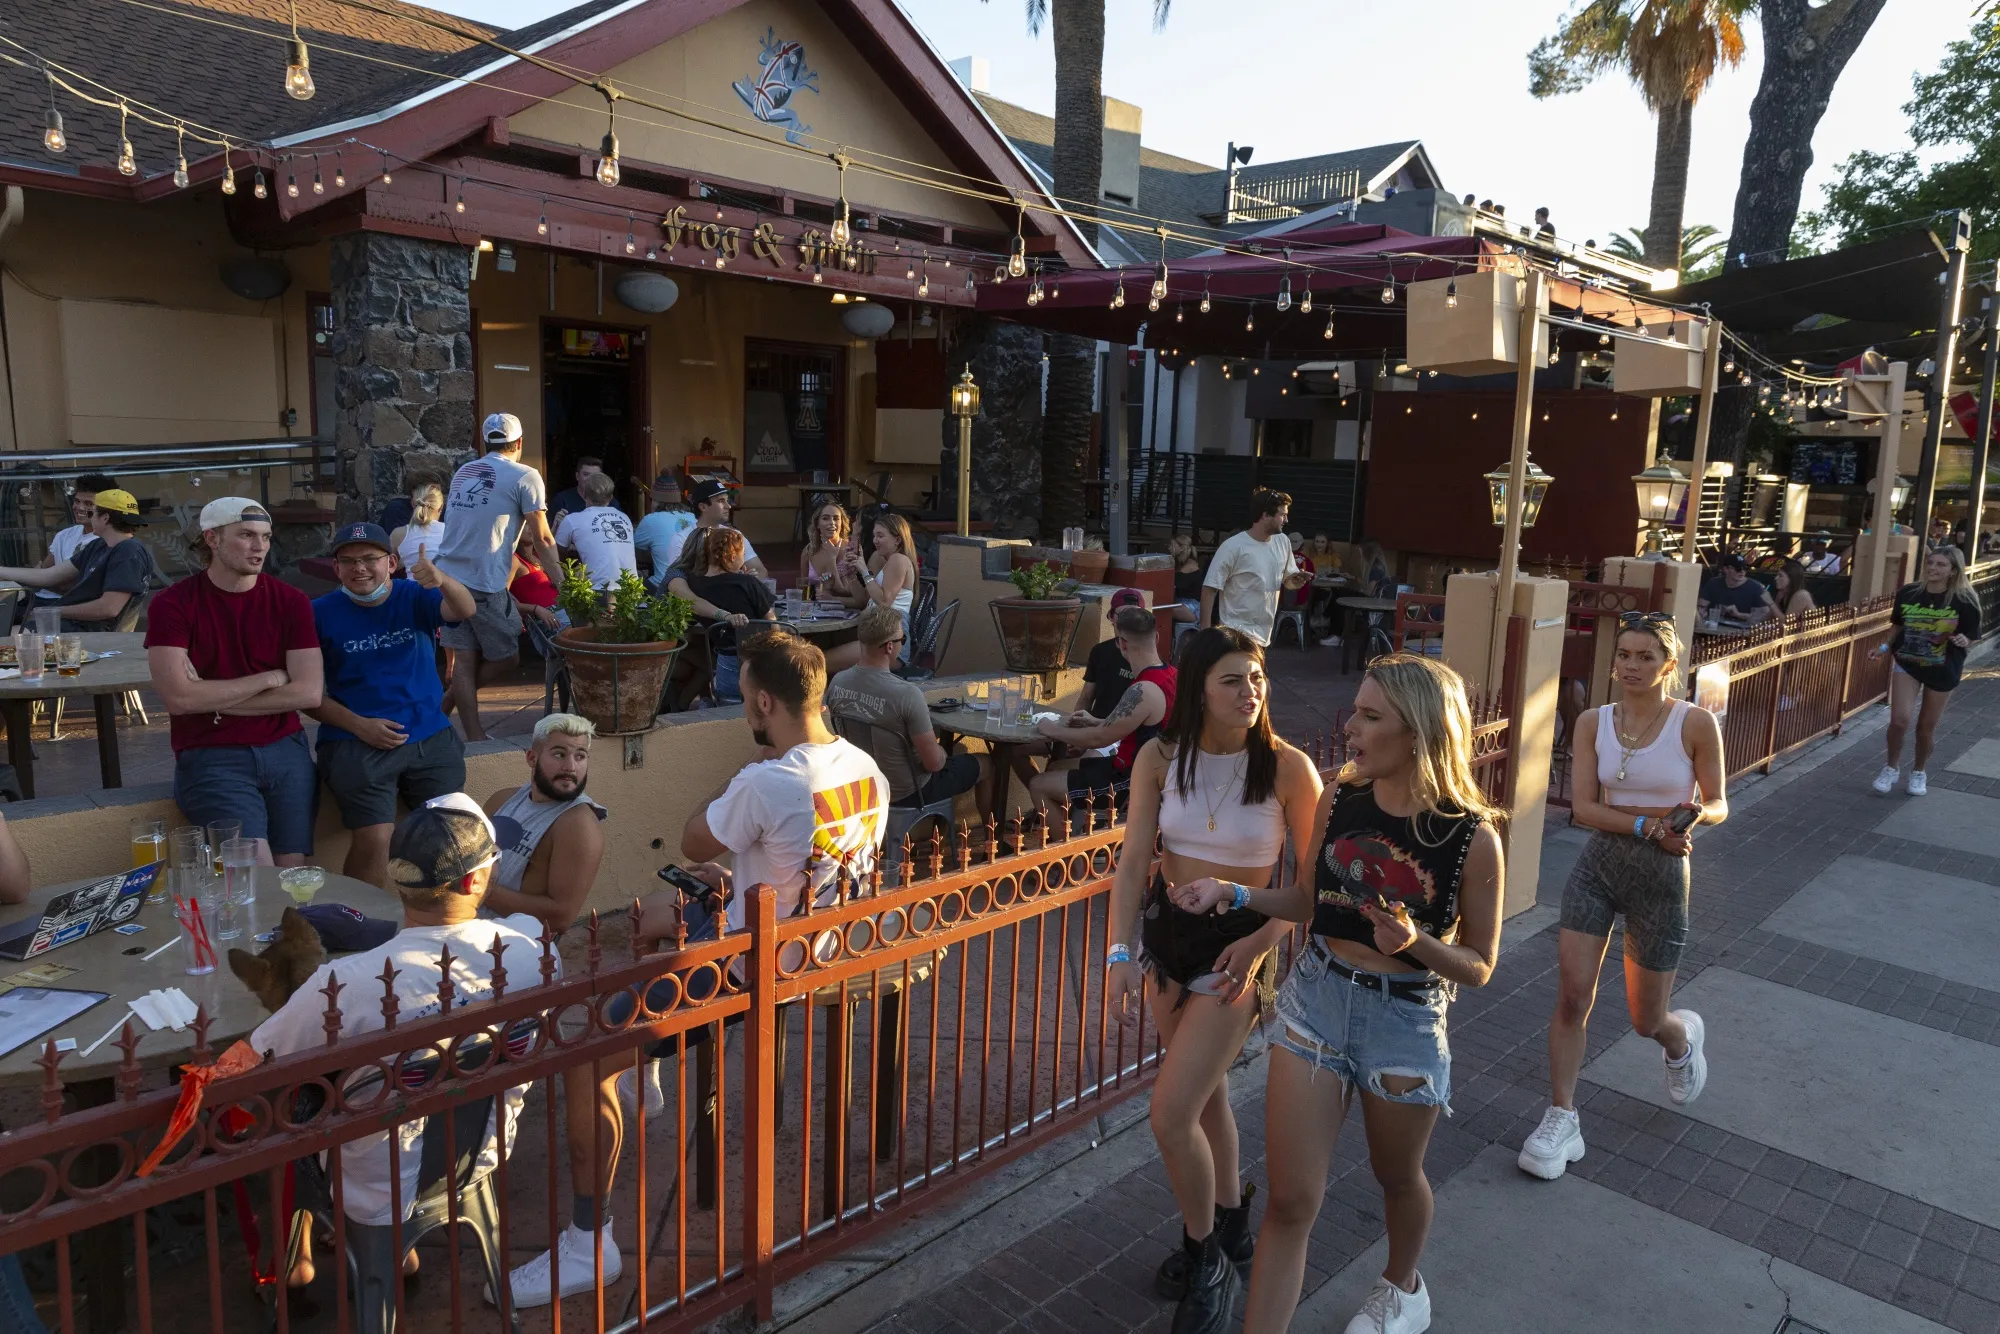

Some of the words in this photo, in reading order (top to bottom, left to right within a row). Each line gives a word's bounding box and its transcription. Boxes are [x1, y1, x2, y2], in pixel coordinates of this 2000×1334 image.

[753, 222, 786, 267] &
[351, 526, 367, 538] A
[343, 627, 413, 653] adidas
[860, 692, 886, 716] RIDGE
[124, 874, 153, 888] NASA
